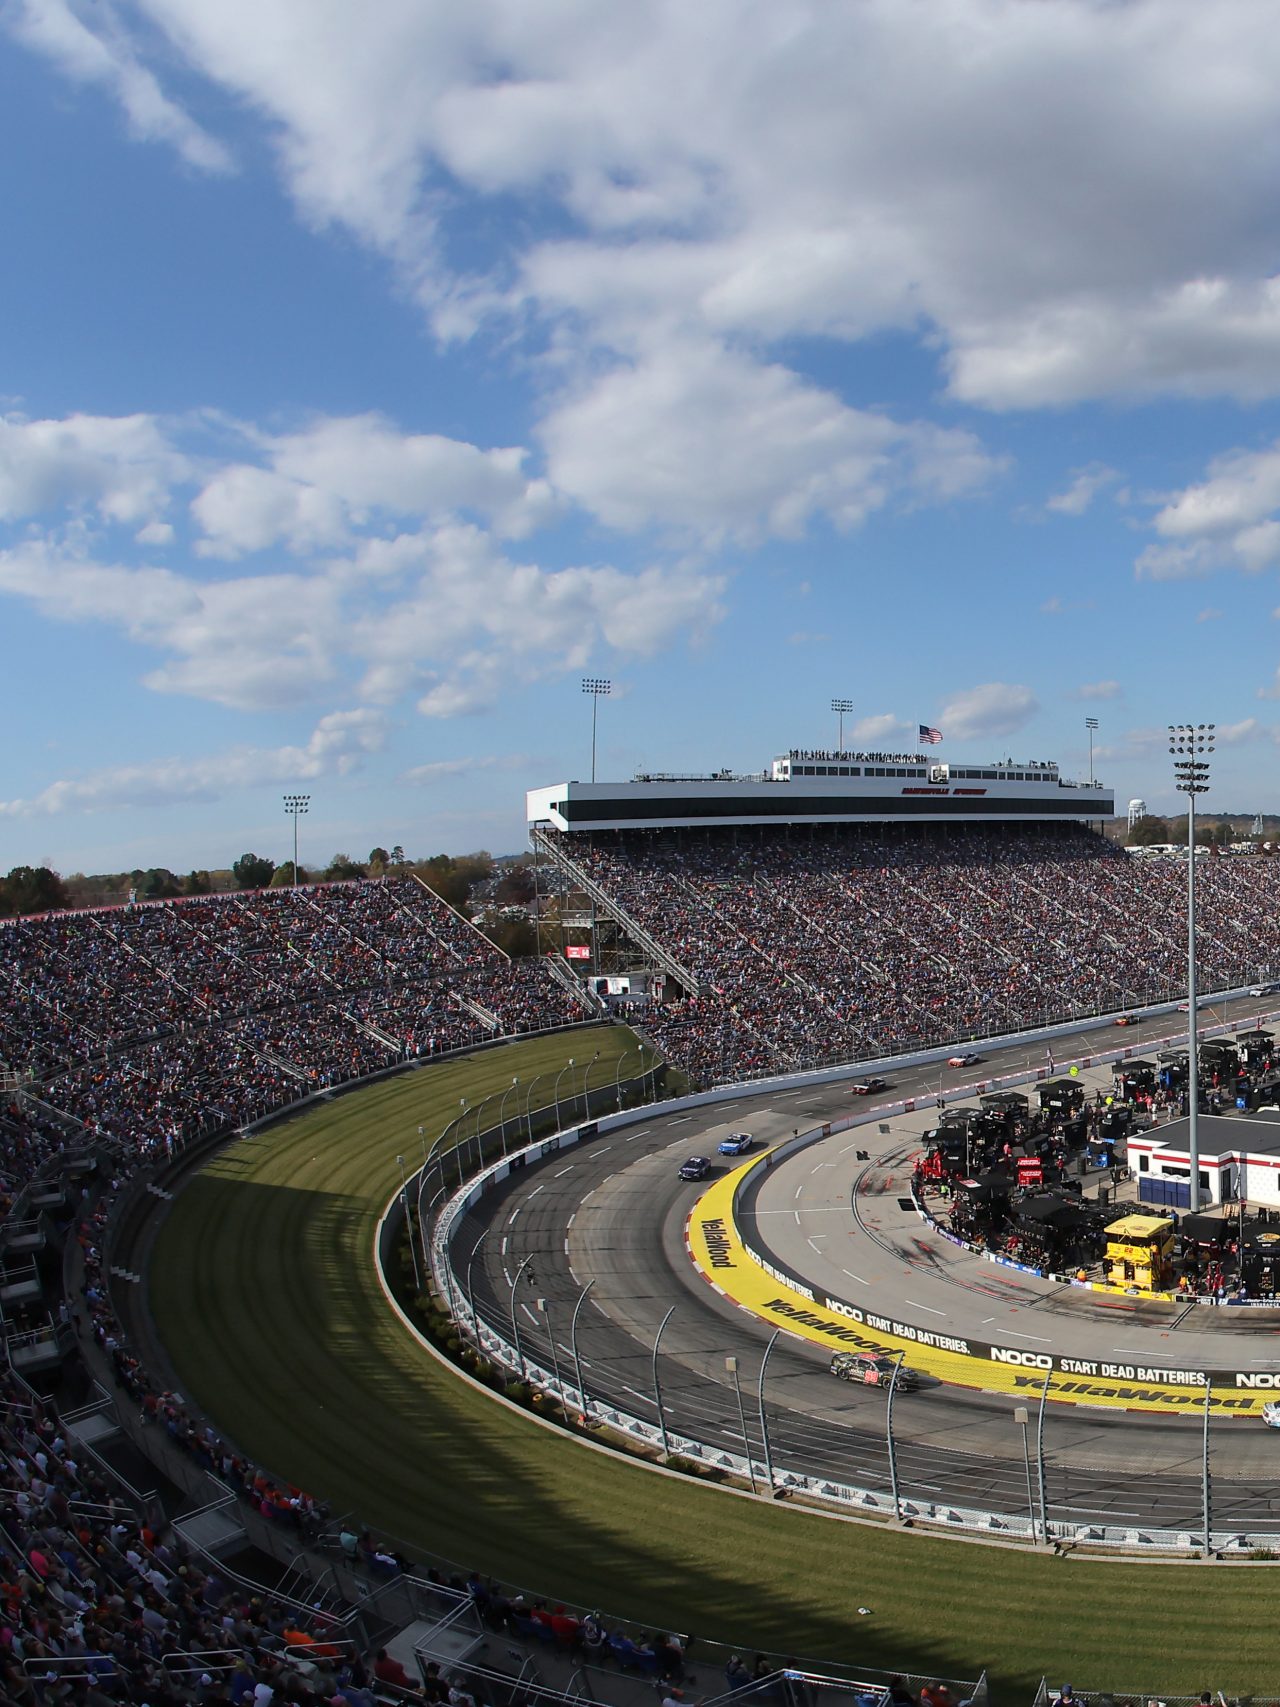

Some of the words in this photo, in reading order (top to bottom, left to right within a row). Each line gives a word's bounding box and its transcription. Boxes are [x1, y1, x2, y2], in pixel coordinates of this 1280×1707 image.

[701, 1218, 737, 1268] YellaWood
[745, 1243, 762, 1268] NOCO
[761, 1298, 906, 1355] YellaWood
[825, 1297, 863, 1323] NOCO
[866, 1314, 891, 1333] START
[892, 1322, 916, 1340] DEAD
[917, 1330, 970, 1354] BATTERIES.
[990, 1346, 1053, 1369] NOCO
[1060, 1358, 1098, 1376] START
[1101, 1363, 1135, 1379] DEAD
[1137, 1367, 1210, 1386] BATTERIES.
[1013, 1375, 1255, 1408] YellaWood
